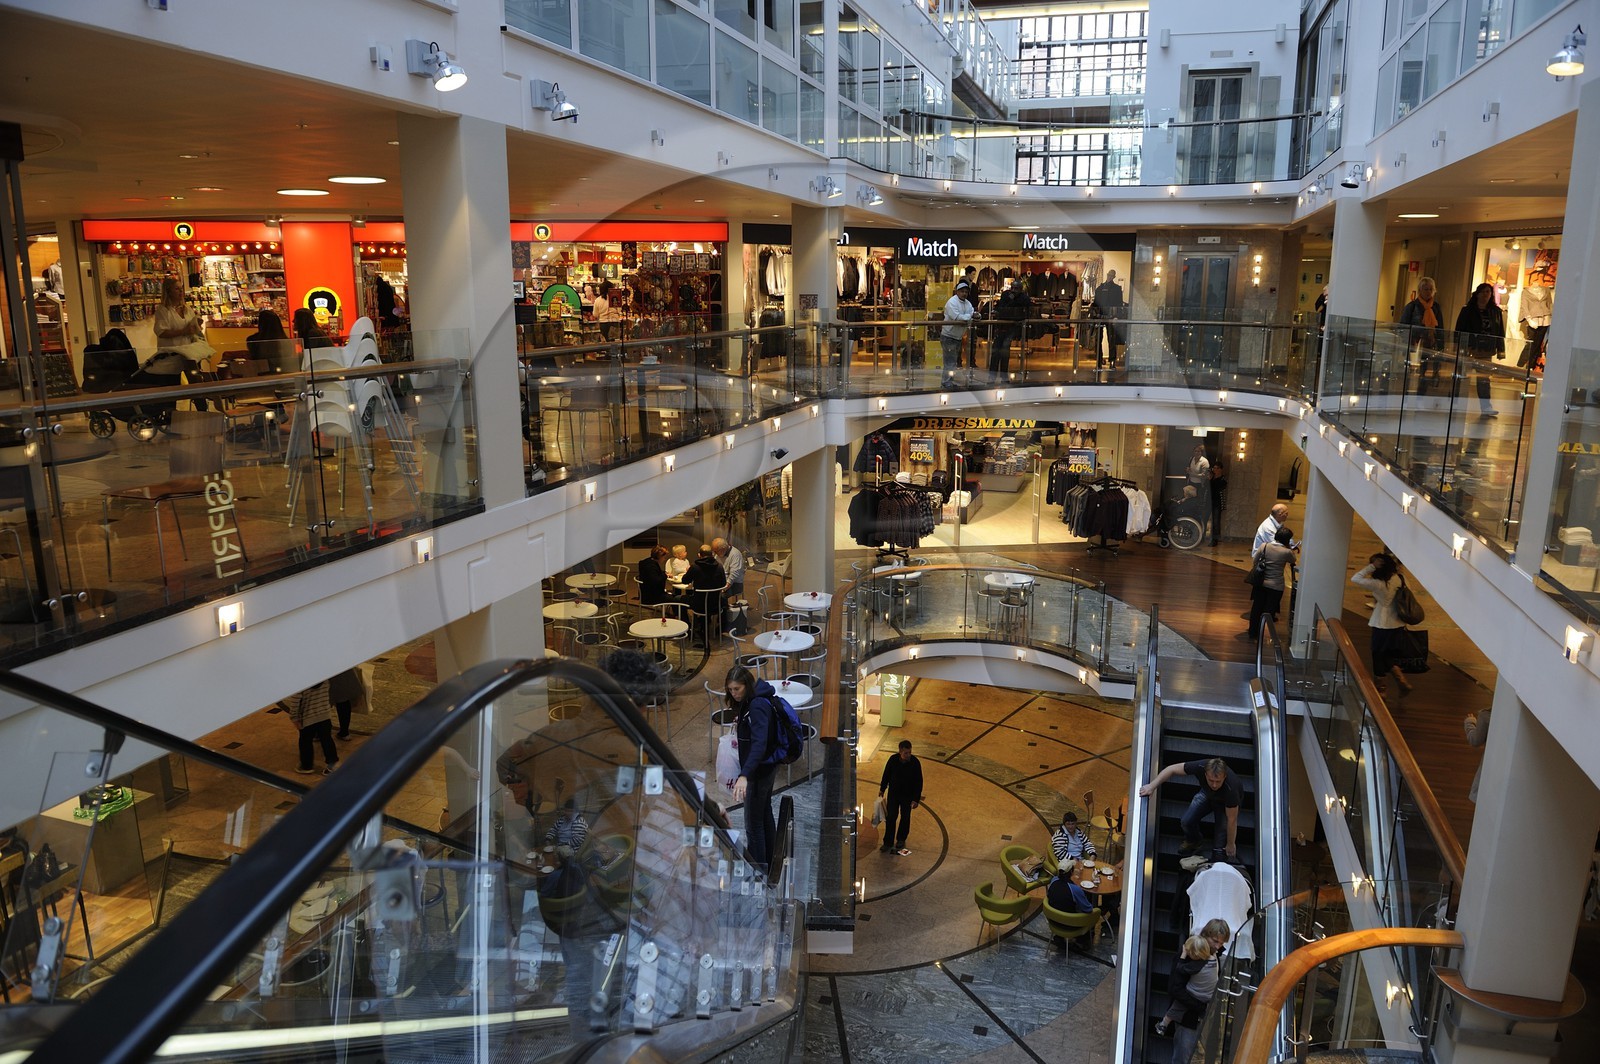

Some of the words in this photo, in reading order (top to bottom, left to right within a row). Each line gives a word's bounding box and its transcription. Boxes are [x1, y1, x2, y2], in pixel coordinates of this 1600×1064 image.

[907, 237, 958, 257] Match
[1023, 233, 1068, 250] Match
[913, 417, 1037, 430] DRESSMANN
[910, 451, 933, 461] 40%
[1068, 463, 1093, 474] 40%
[766, 487, 780, 499] 40%
[766, 516, 781, 528] 40%
[757, 530, 787, 539] DRESS
